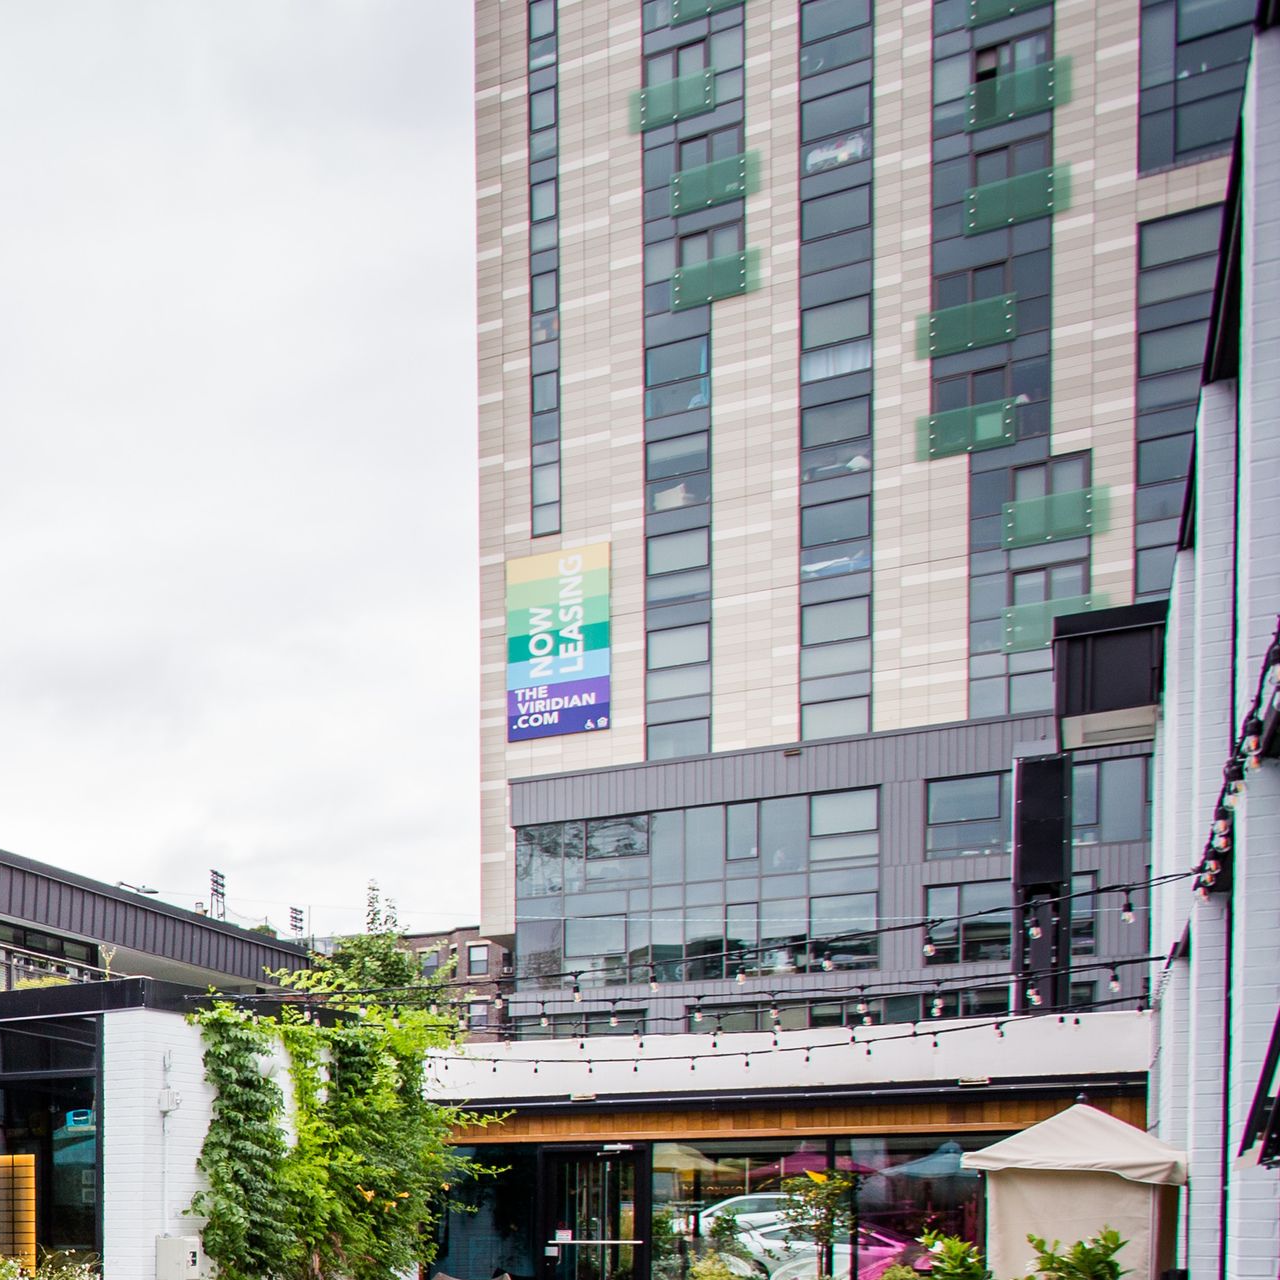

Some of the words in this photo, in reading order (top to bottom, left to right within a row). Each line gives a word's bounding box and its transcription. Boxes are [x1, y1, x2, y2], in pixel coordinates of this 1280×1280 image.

[559, 553, 584, 674] LEASING
[529, 607, 554, 679] NOW
[515, 686, 548, 702] THE
[517, 692, 596, 715] VIRIDIAN
[512, 711, 559, 730] .COM
